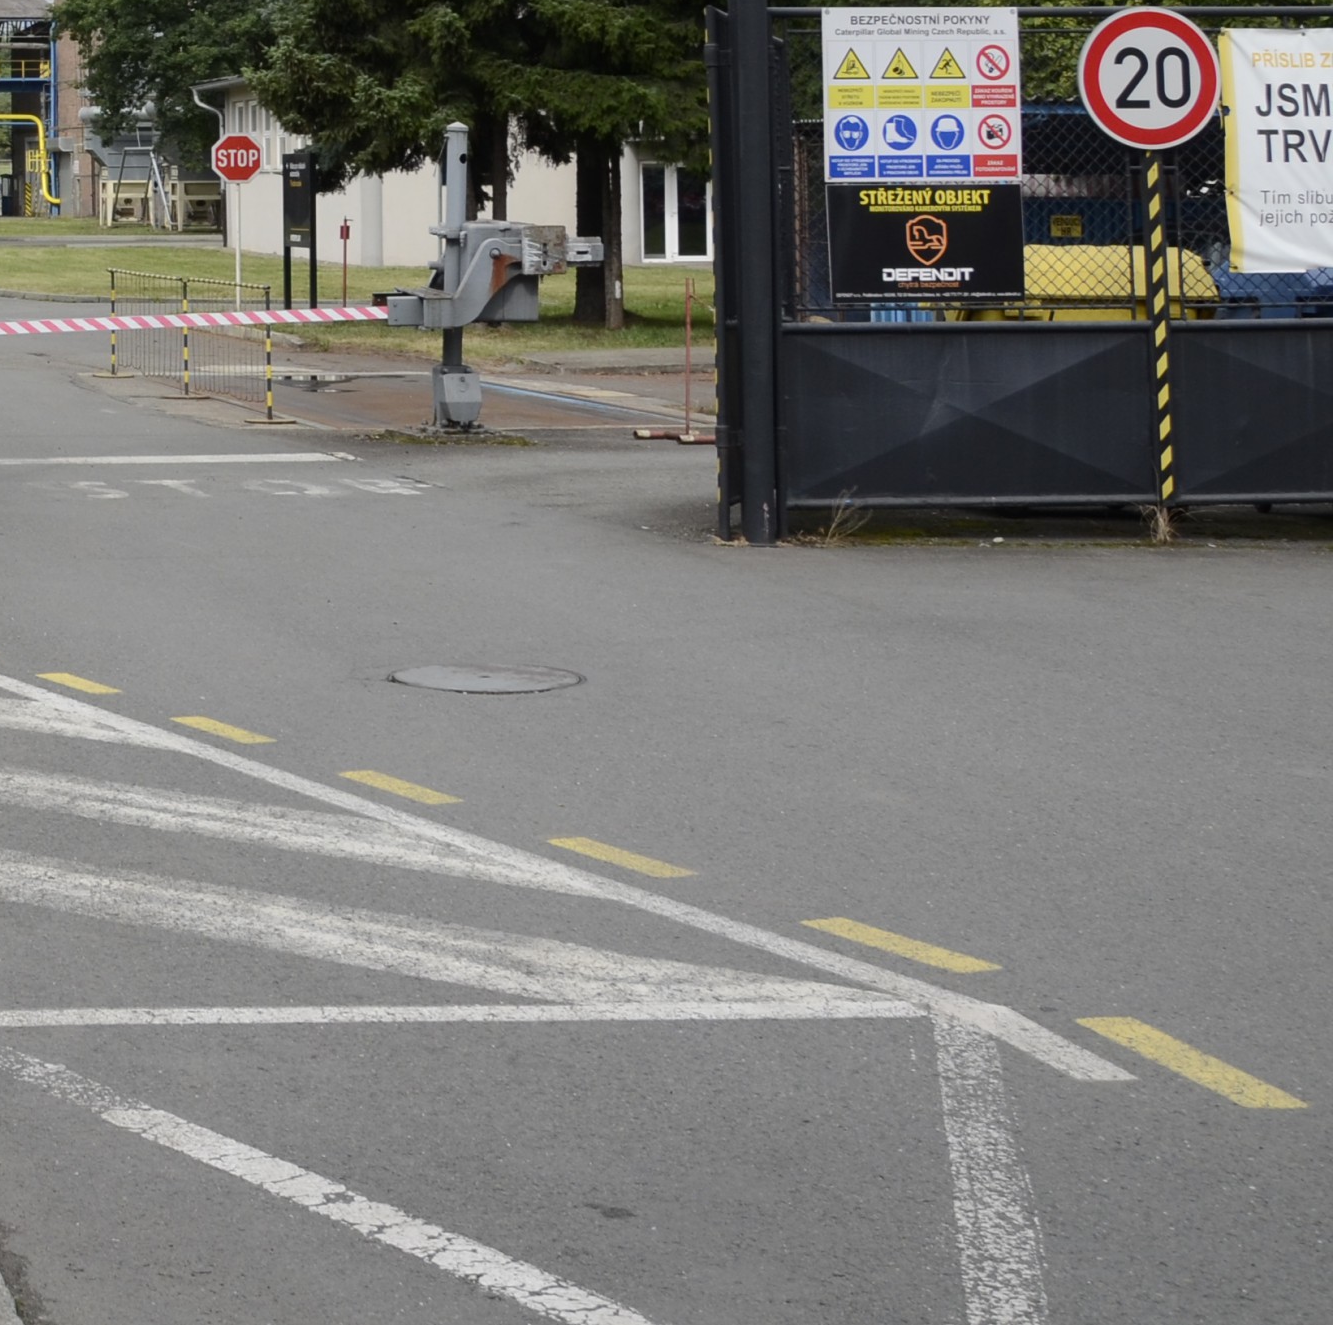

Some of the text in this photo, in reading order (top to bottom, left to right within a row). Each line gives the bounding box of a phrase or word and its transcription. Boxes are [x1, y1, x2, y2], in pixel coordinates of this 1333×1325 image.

[850, 13, 990, 25] BEZPEČNOSTNÍ POKYNY
[835, 28, 875, 37] Caterpillar
[877, 28, 902, 36] Global
[904, 28, 930, 37] Mining
[931, 28, 955, 36] Czech
[1251, 49, 1333, 69] PŘÍSLIB Z
[1113, 46, 1192, 110] 20
[1255, 83, 1331, 118] JSM
[1257, 129, 1332, 163] TRV
[217, 149, 259, 168] STOP
[859, 187, 991, 205] STŘEŽENÝ OBJEKT
[1260, 189, 1292, 205] Tím
[1259, 210, 1303, 227] jejich
[882, 268, 975, 282] DEFENDIT
